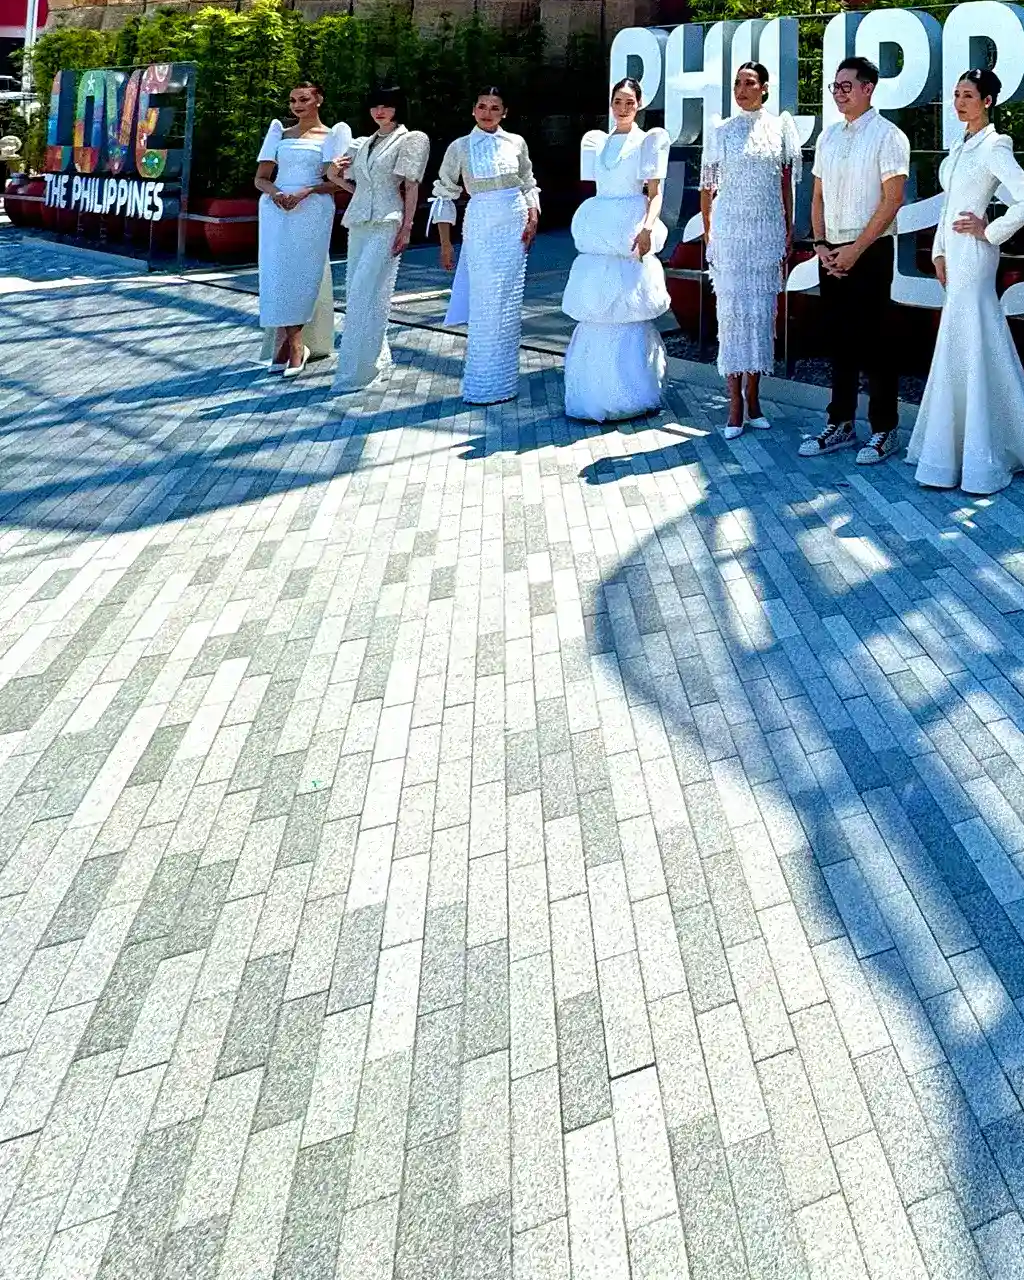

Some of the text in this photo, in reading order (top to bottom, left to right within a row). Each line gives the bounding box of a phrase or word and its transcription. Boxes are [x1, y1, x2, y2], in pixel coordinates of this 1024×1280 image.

[44, 65, 174, 178] LOVE
[44, 173, 165, 221] THE PHILIPPINES
